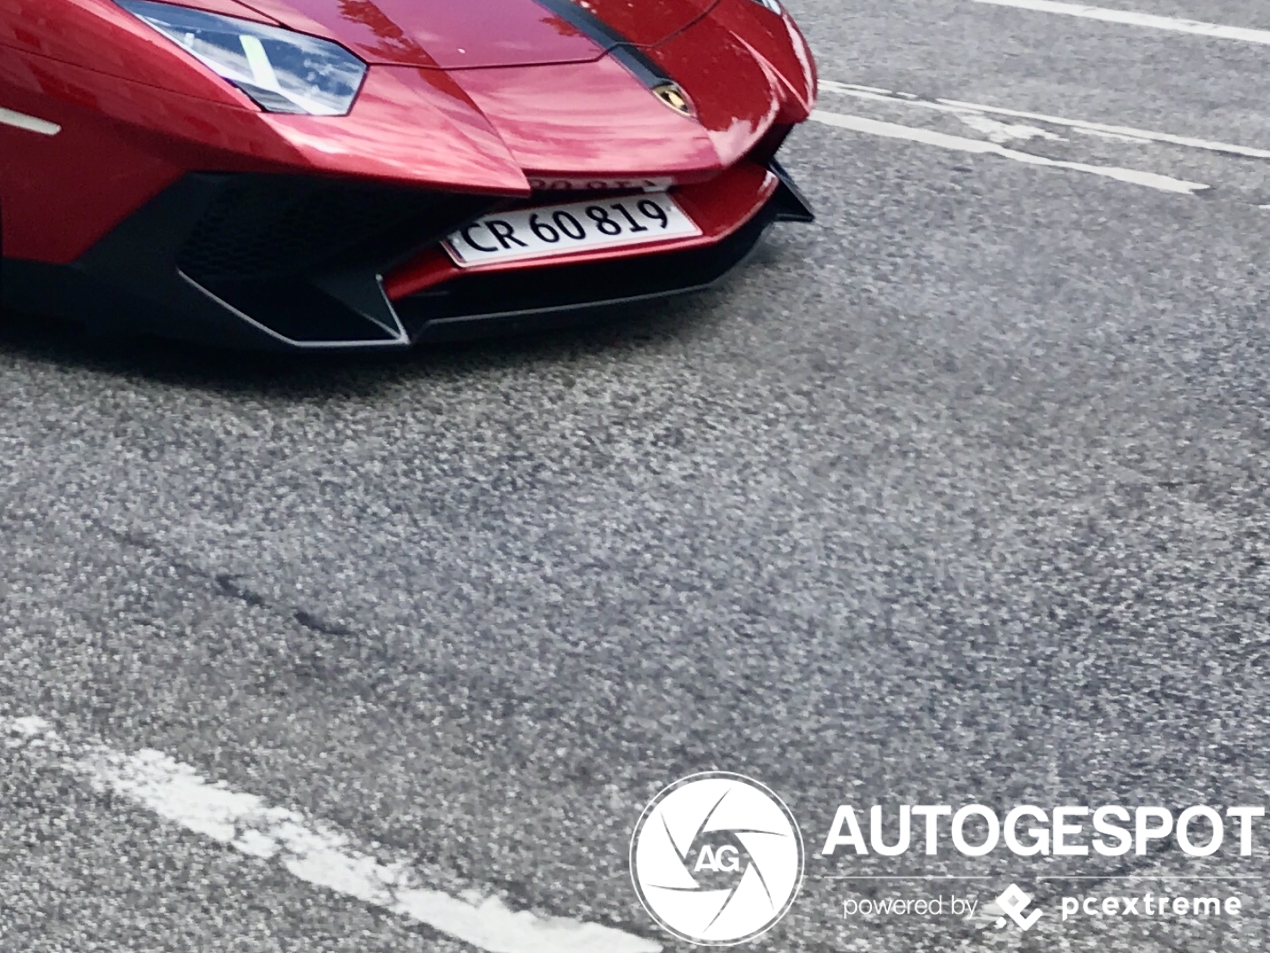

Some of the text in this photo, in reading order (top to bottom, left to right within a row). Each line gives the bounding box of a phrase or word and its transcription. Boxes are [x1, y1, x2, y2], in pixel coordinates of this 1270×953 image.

[461, 199, 668, 252] CR 60 819
